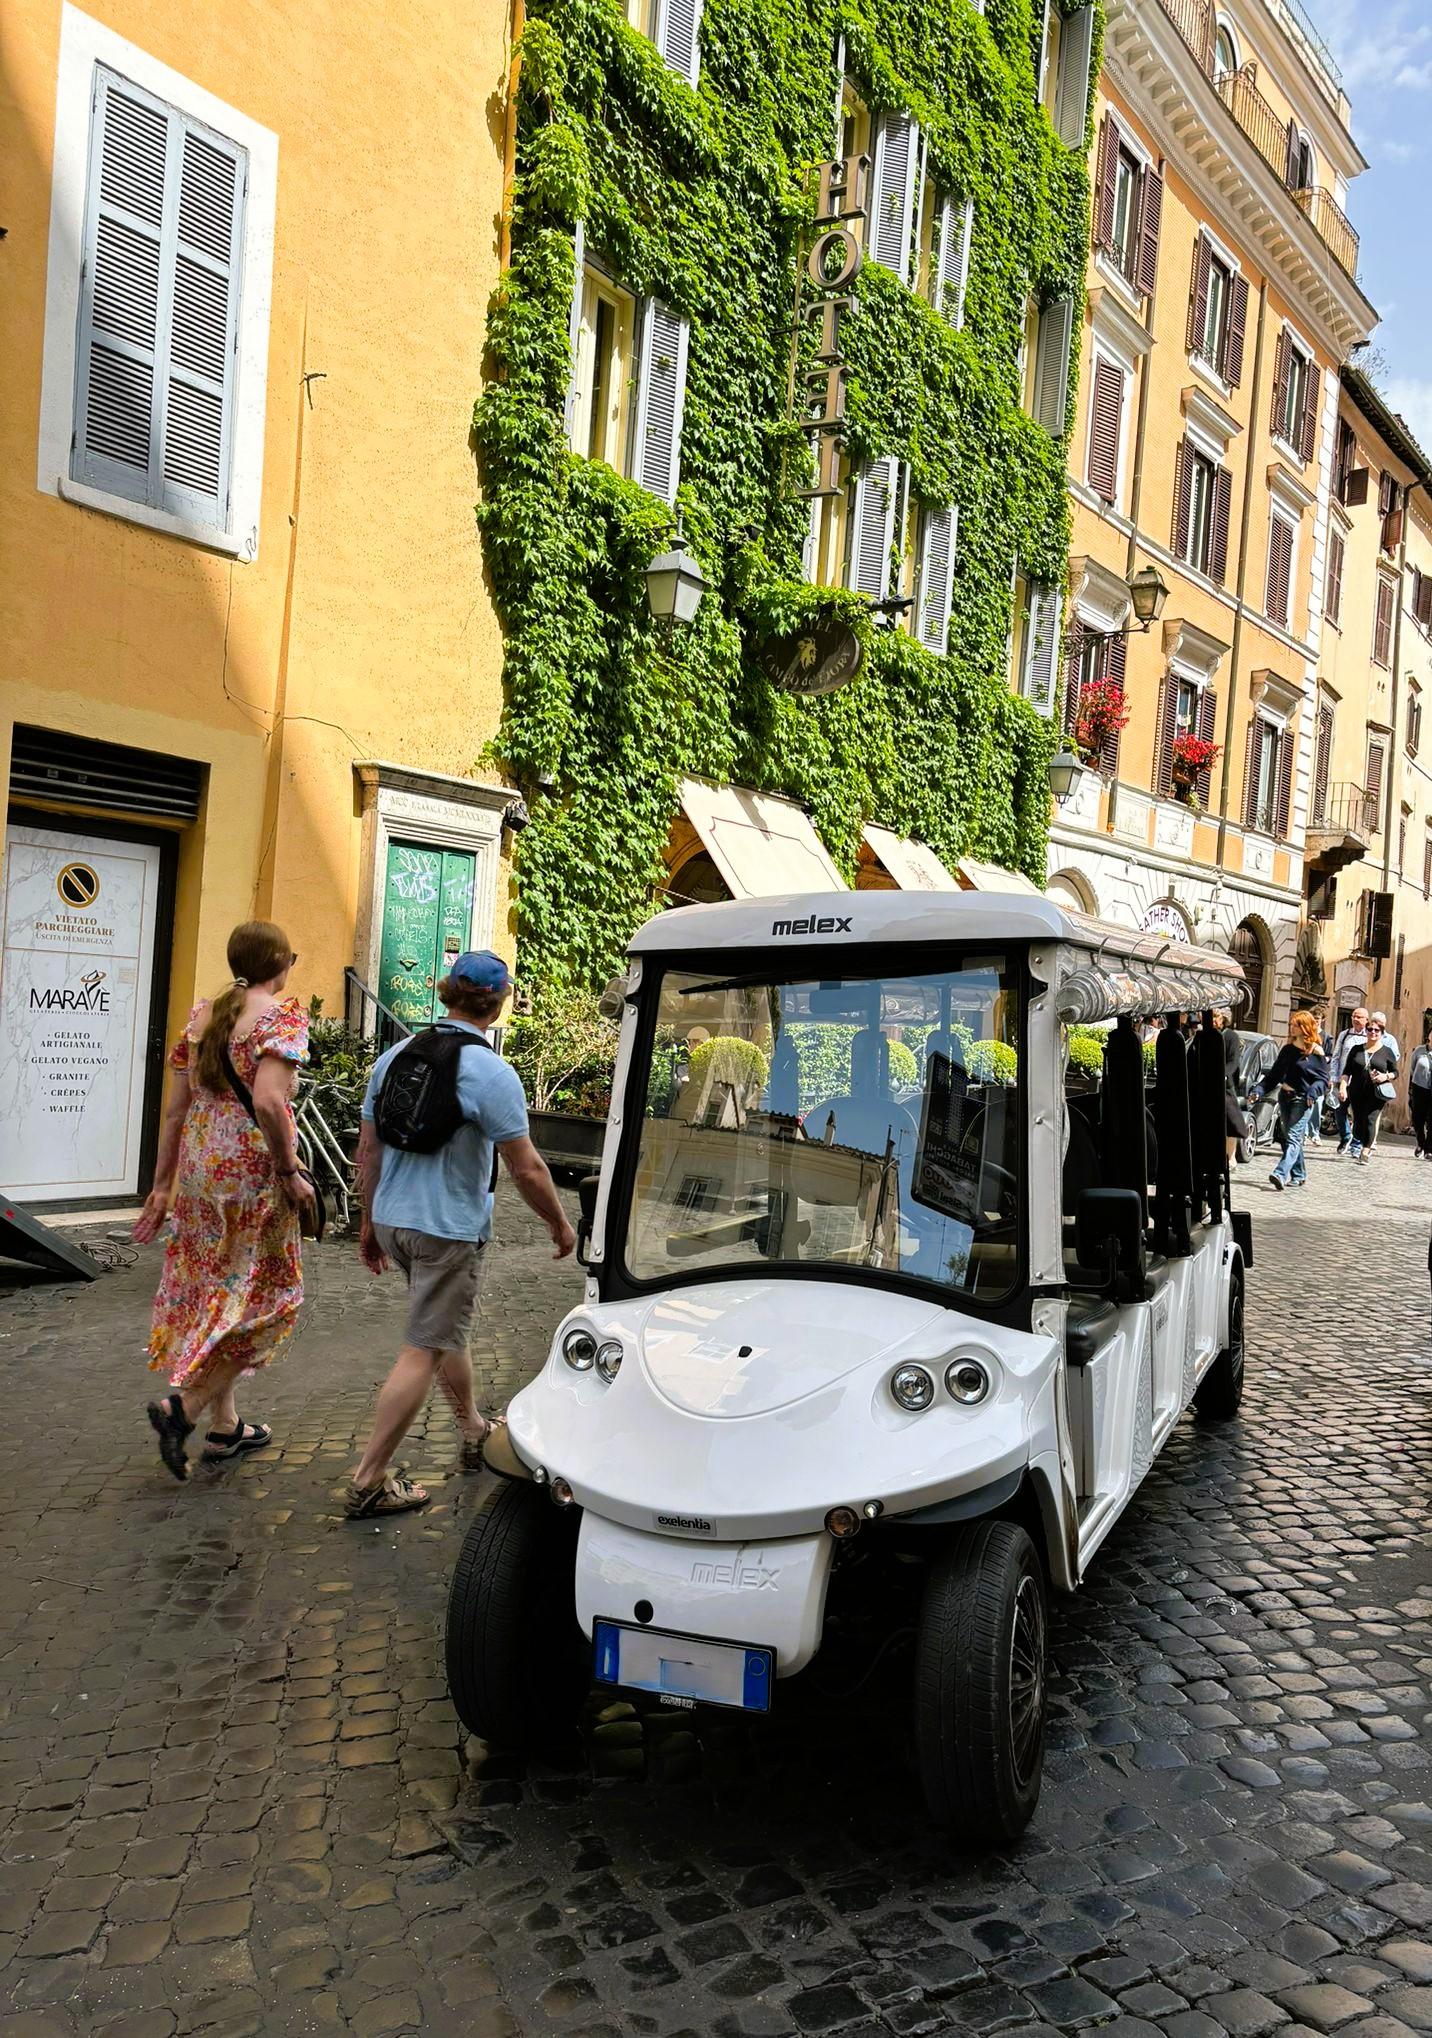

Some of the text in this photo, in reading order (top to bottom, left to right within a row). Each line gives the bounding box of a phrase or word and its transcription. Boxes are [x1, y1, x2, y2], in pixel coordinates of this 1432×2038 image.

[765, 654, 799, 686] CAMPO
[55, 915, 97, 926] VIETATO
[772, 914, 853, 936] melex
[1139, 906, 1170, 932] ATHER
[1170, 912, 1189, 944] SHO
[35, 922, 115, 936] PARCHEGGIARE
[71, 936, 113, 946] EMERGENZA
[29, 984, 110, 1012] MARAVÈ
[54, 1031, 91, 1040] GELATO
[40, 1040, 103, 1049] ARTIGIANALE
[31, 1056, 109, 1065] GELATO VEGANO
[49, 1073, 90, 1081] GRANITE
[50, 1088, 87, 1097] CRÊPES
[49, 1105, 87, 1113] WAFFLE
[657, 1515, 711, 1531] exelentia
